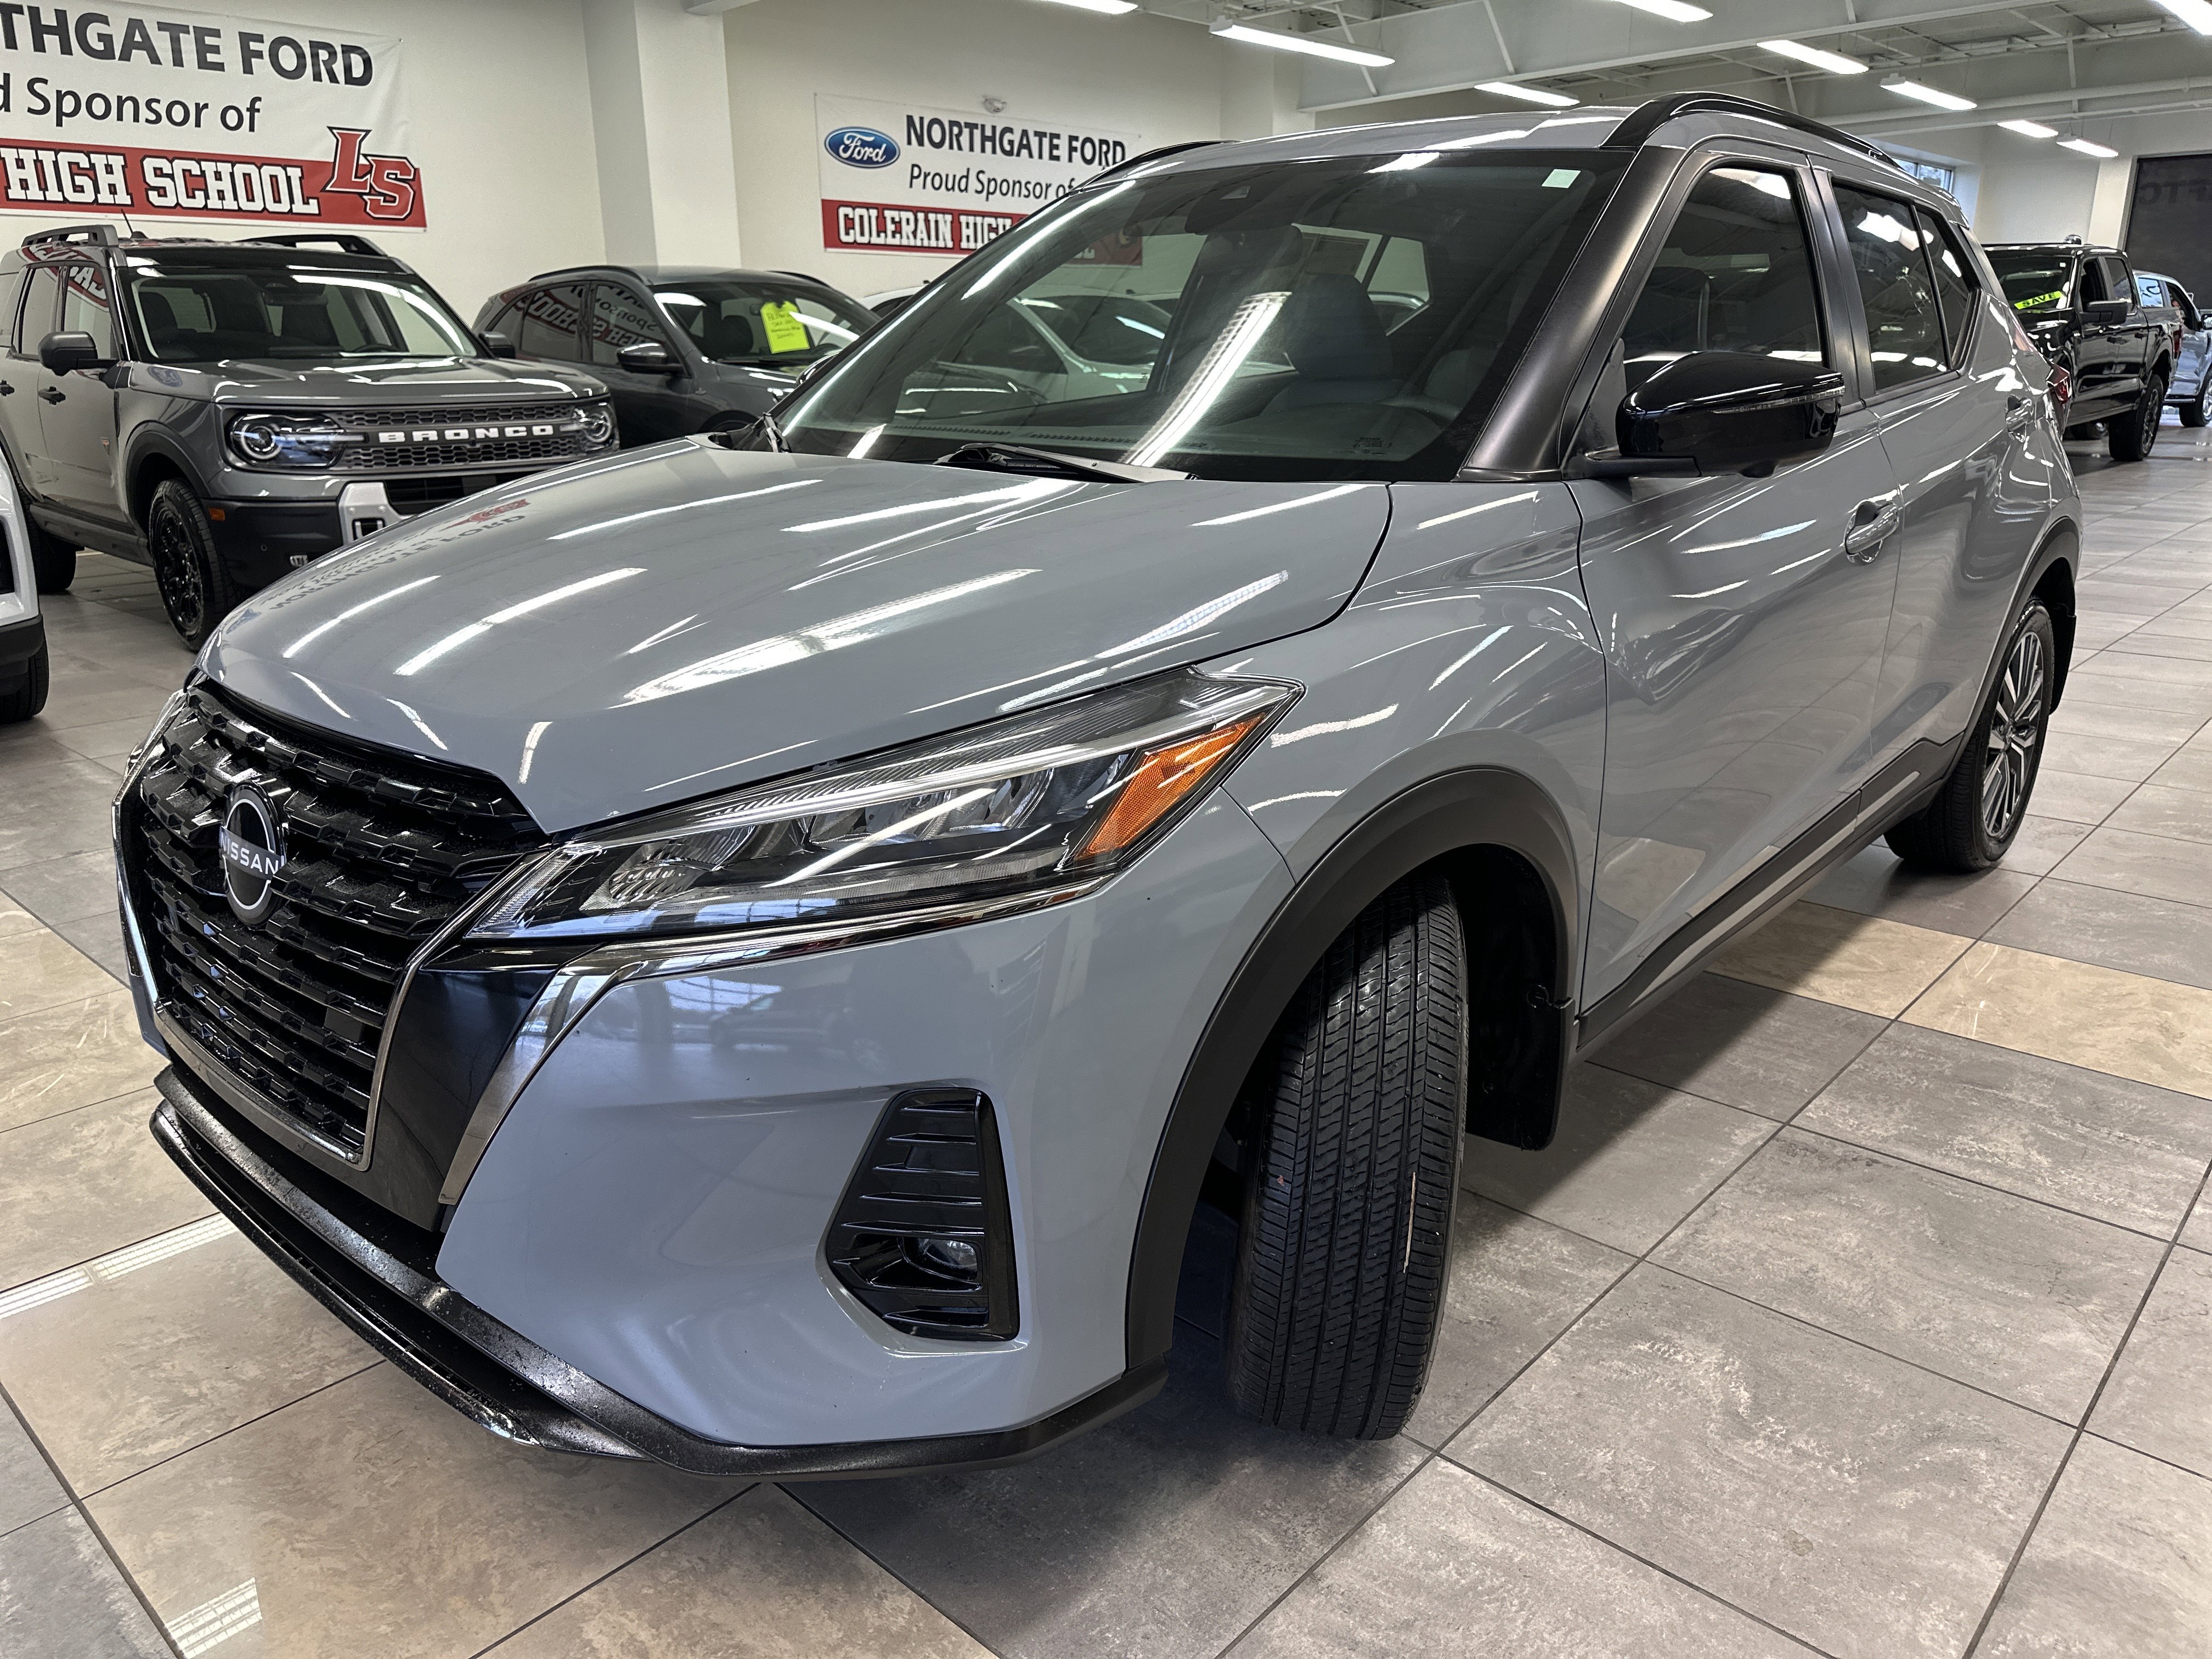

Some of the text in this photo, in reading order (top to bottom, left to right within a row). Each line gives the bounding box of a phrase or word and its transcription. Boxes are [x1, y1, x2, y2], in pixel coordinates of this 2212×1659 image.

[238, 31, 373, 87] FORD
[26, 77, 209, 127] Sponsor
[219, 96, 262, 133] of
[839, 132, 887, 162] Ford
[906, 114, 1125, 167] NORTHGATE FORD
[0, 147, 321, 216] HIGH SCHOOL
[909, 163, 970, 193] Proud
[974, 170, 1052, 201] Sponsor
[837, 205, 953, 249] COLERAIN
[2022, 293, 2056, 307] SAVE
[378, 425, 554, 443] BRONCO
[219, 831, 279, 874] NISSAN
